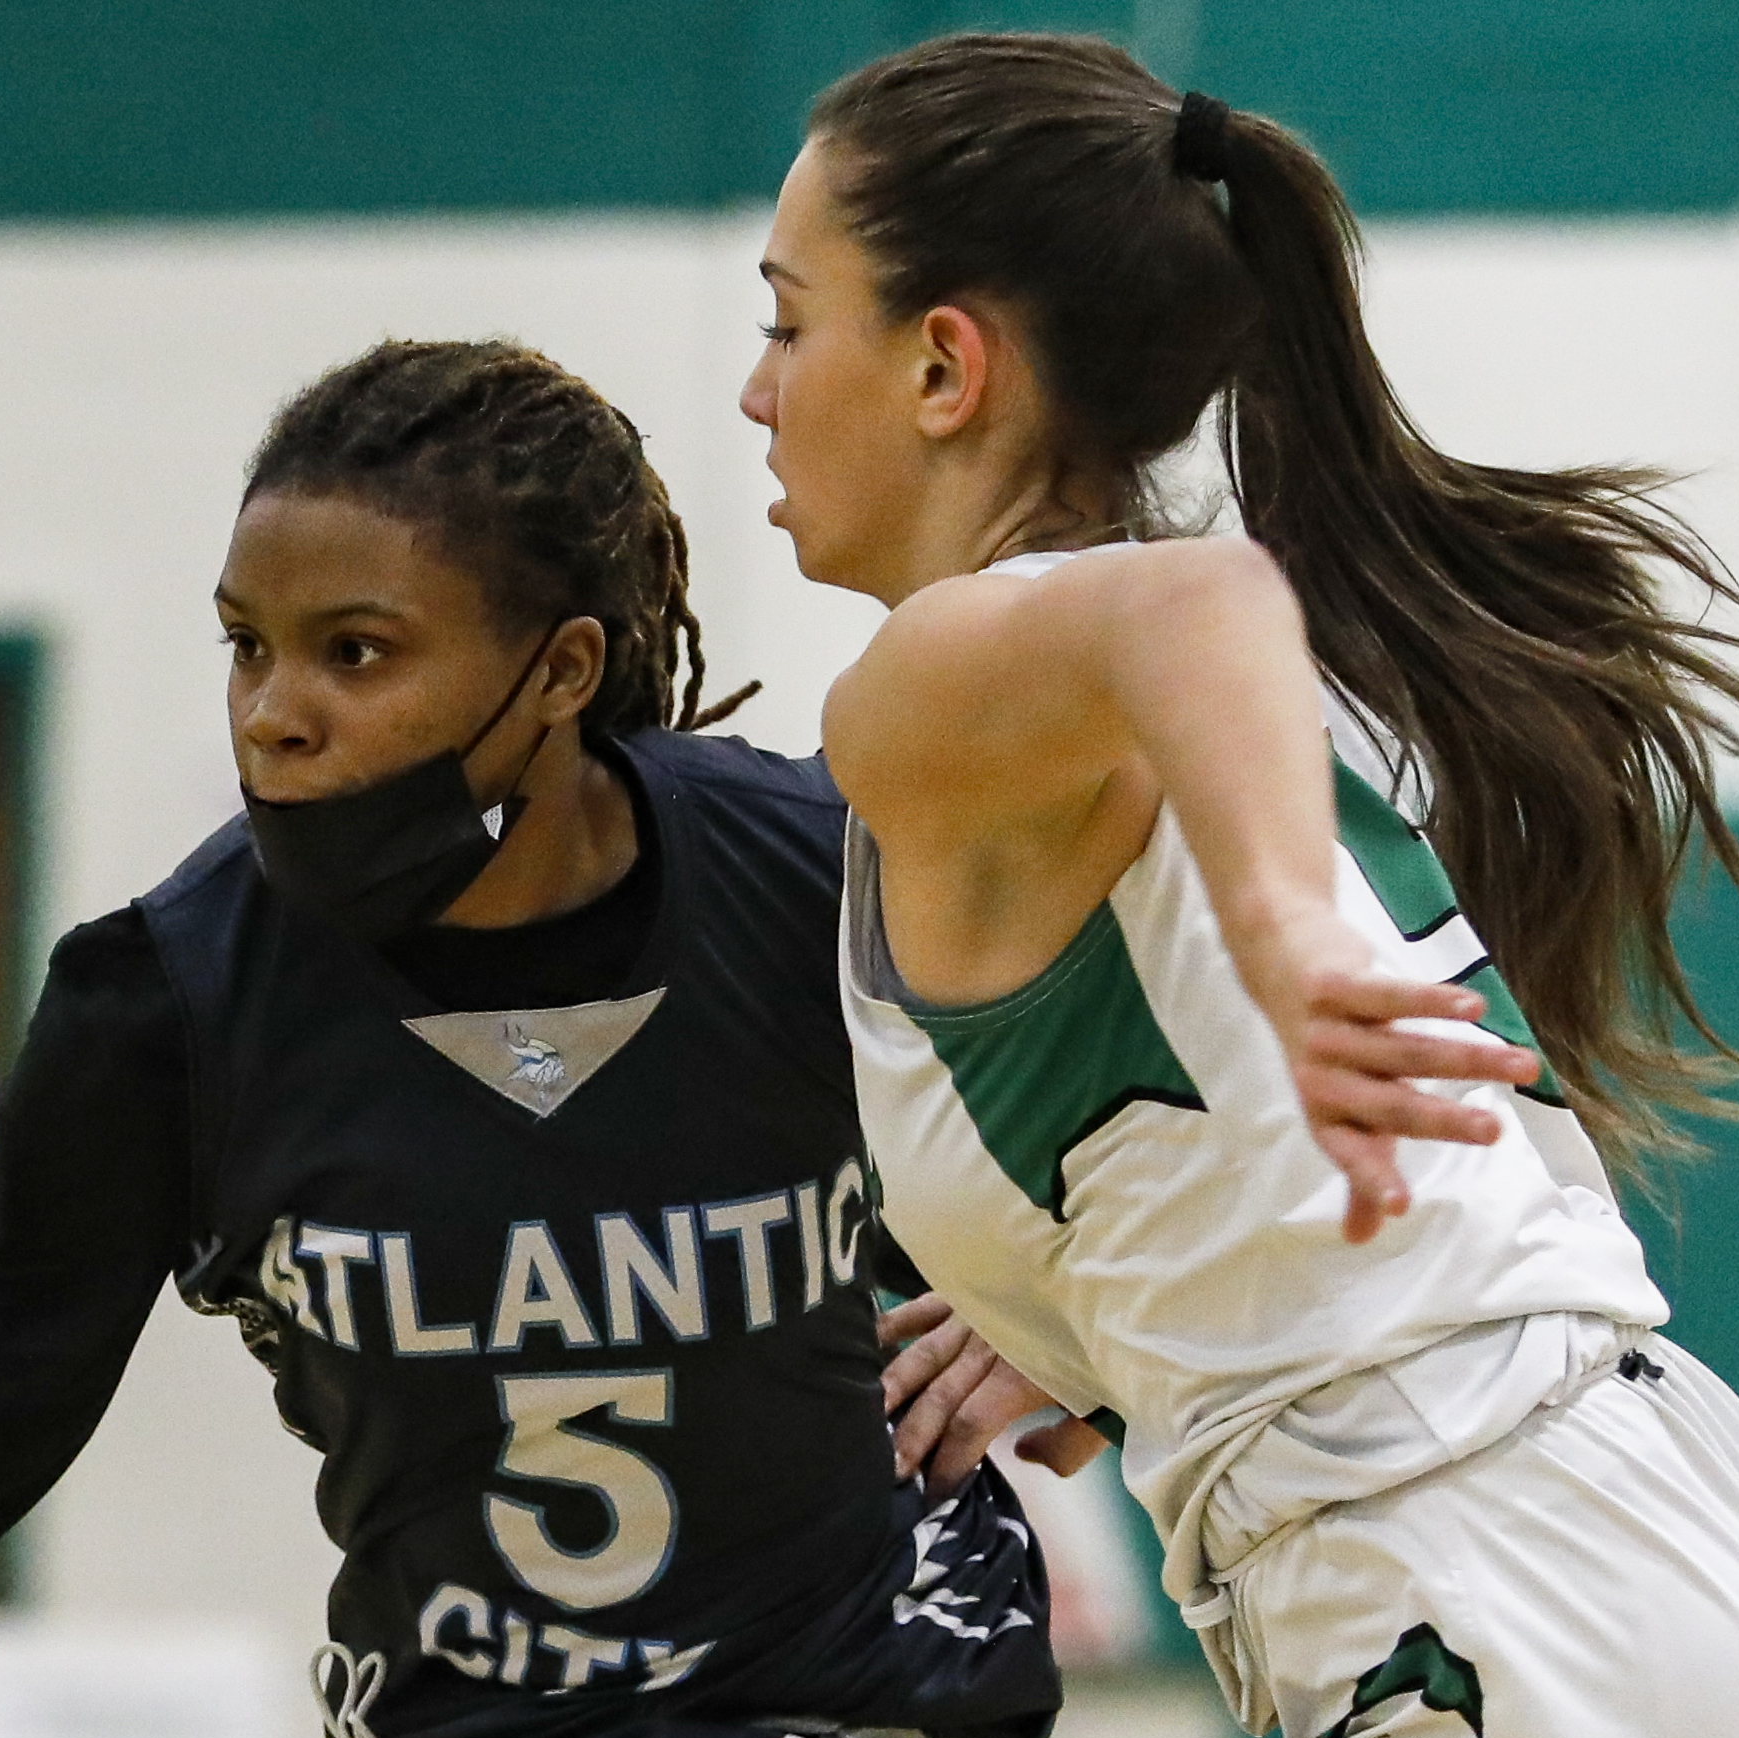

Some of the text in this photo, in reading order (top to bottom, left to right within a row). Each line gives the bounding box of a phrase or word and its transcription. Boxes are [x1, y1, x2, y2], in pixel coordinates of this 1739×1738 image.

[261, 1156, 868, 1358] ATLANTIC
[483, 1367, 680, 1611] 5
[419, 1581, 718, 1695] CITY
